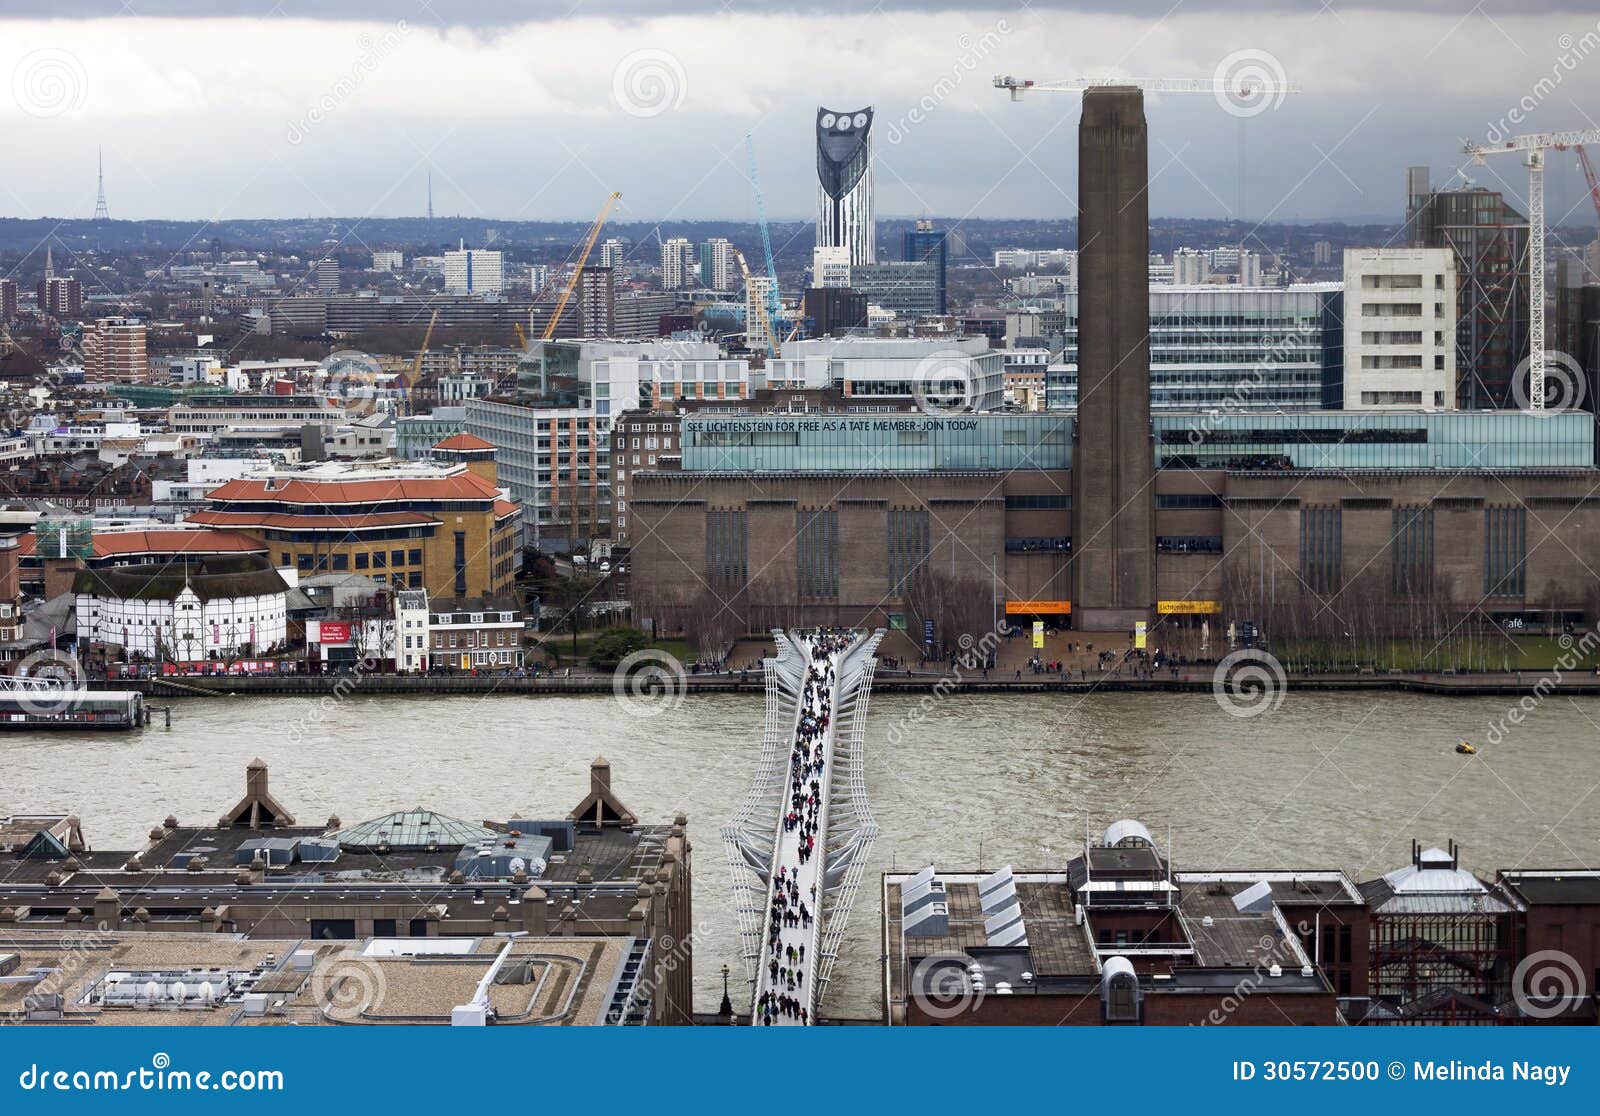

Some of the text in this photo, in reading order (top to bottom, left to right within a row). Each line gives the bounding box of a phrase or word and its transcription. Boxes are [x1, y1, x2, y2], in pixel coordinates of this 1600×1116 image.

[688, 422, 703, 432] SEE
[706, 422, 773, 432] LICHTENSTEIN
[776, 421, 795, 432] FOR
[798, 421, 819, 432] FREE
[823, 421, 837, 431] AS
[839, 421, 847, 431] A
[849, 421, 870, 431] TATE
[946, 420, 978, 431] TODAY
